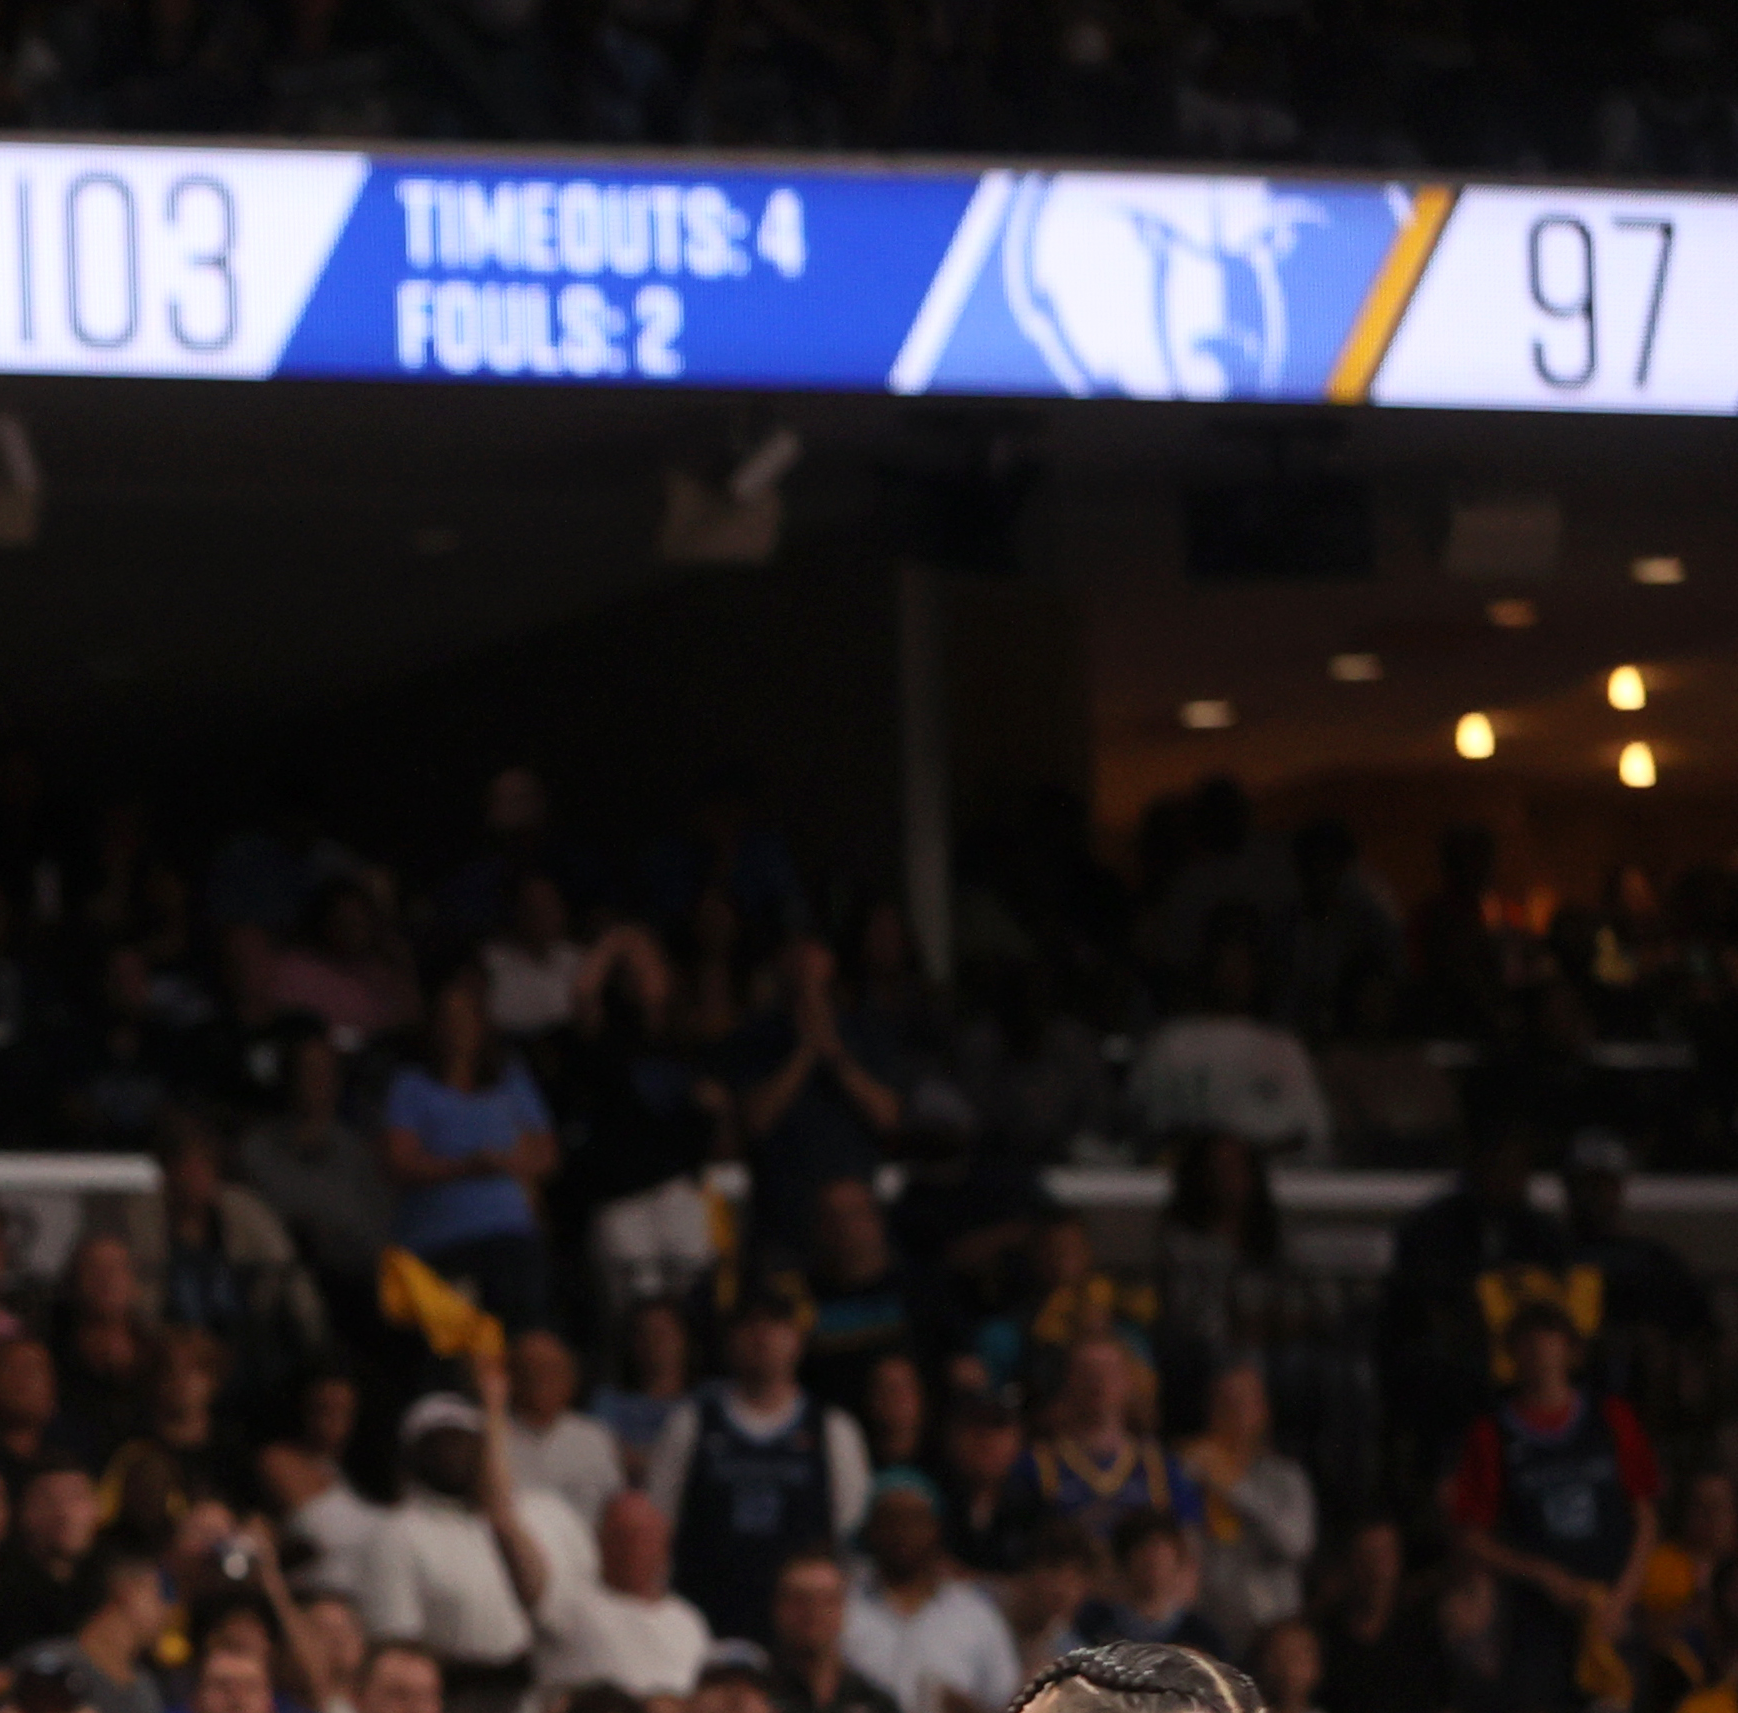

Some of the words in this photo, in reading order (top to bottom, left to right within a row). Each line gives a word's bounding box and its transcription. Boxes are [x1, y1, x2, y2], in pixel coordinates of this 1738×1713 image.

[19, 172, 236, 350] 103
[396, 178, 751, 278] TIMEOUTS:
[759, 187, 808, 279] 4
[397, 278, 625, 377] FOULS:
[633, 284, 686, 378] 2
[1529, 214, 1674, 390] 97
